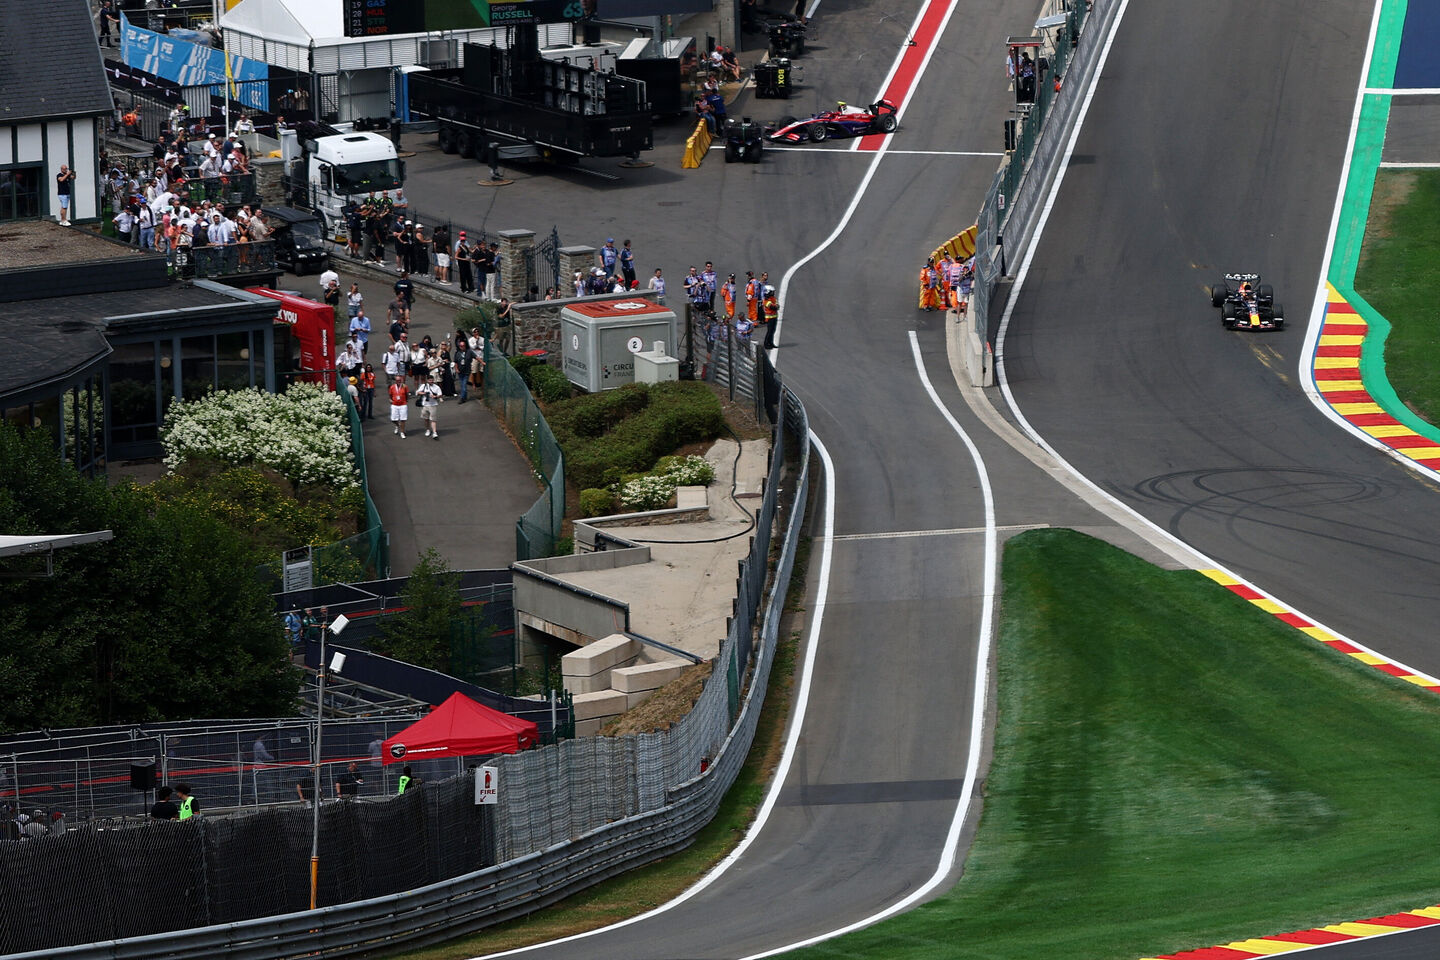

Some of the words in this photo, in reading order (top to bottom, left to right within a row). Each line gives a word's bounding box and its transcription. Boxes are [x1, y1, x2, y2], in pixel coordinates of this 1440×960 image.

[492, 10, 533, 20] RUSSELL
[563, 2, 584, 18] 63
[283, 309, 298, 324] YOU
[633, 341, 637, 349] 2
